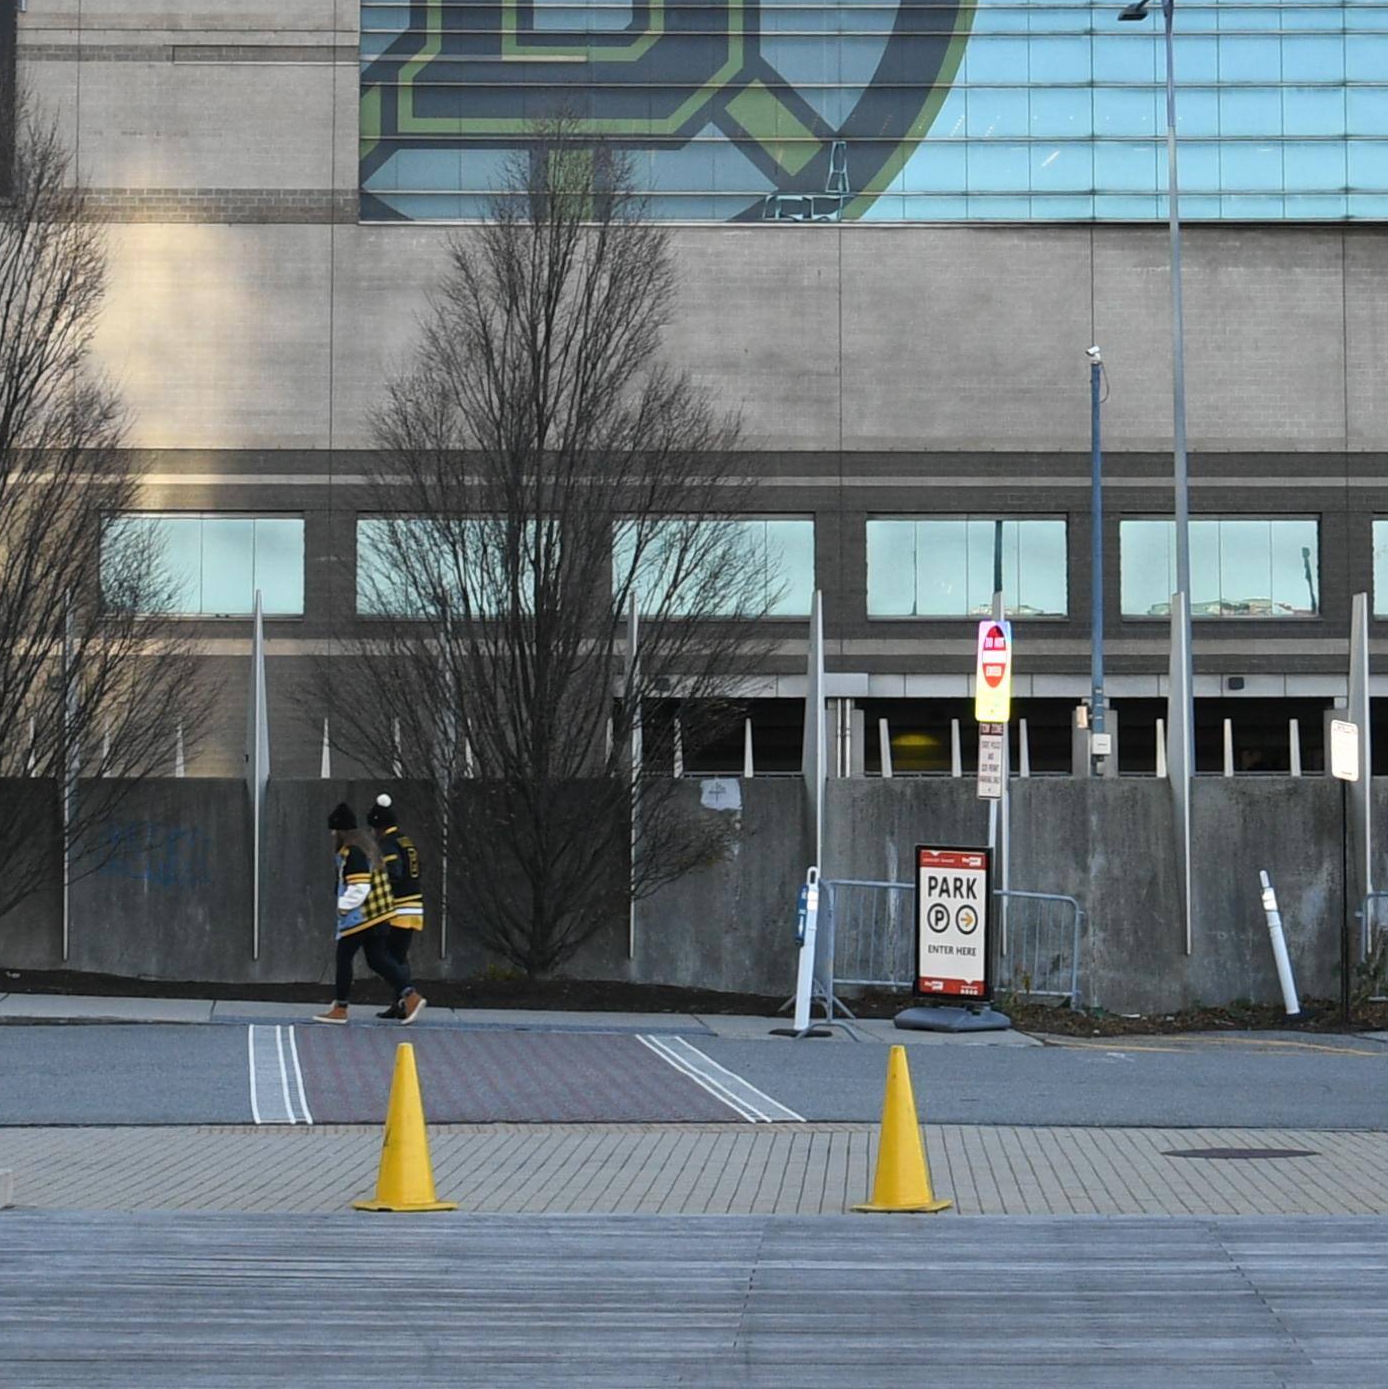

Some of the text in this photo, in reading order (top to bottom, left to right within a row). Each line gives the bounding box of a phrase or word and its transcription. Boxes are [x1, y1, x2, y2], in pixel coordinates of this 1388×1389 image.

[928, 875, 978, 900] PARK
[934, 909, 945, 927] P
[928, 944, 977, 957] ENTER HERE
